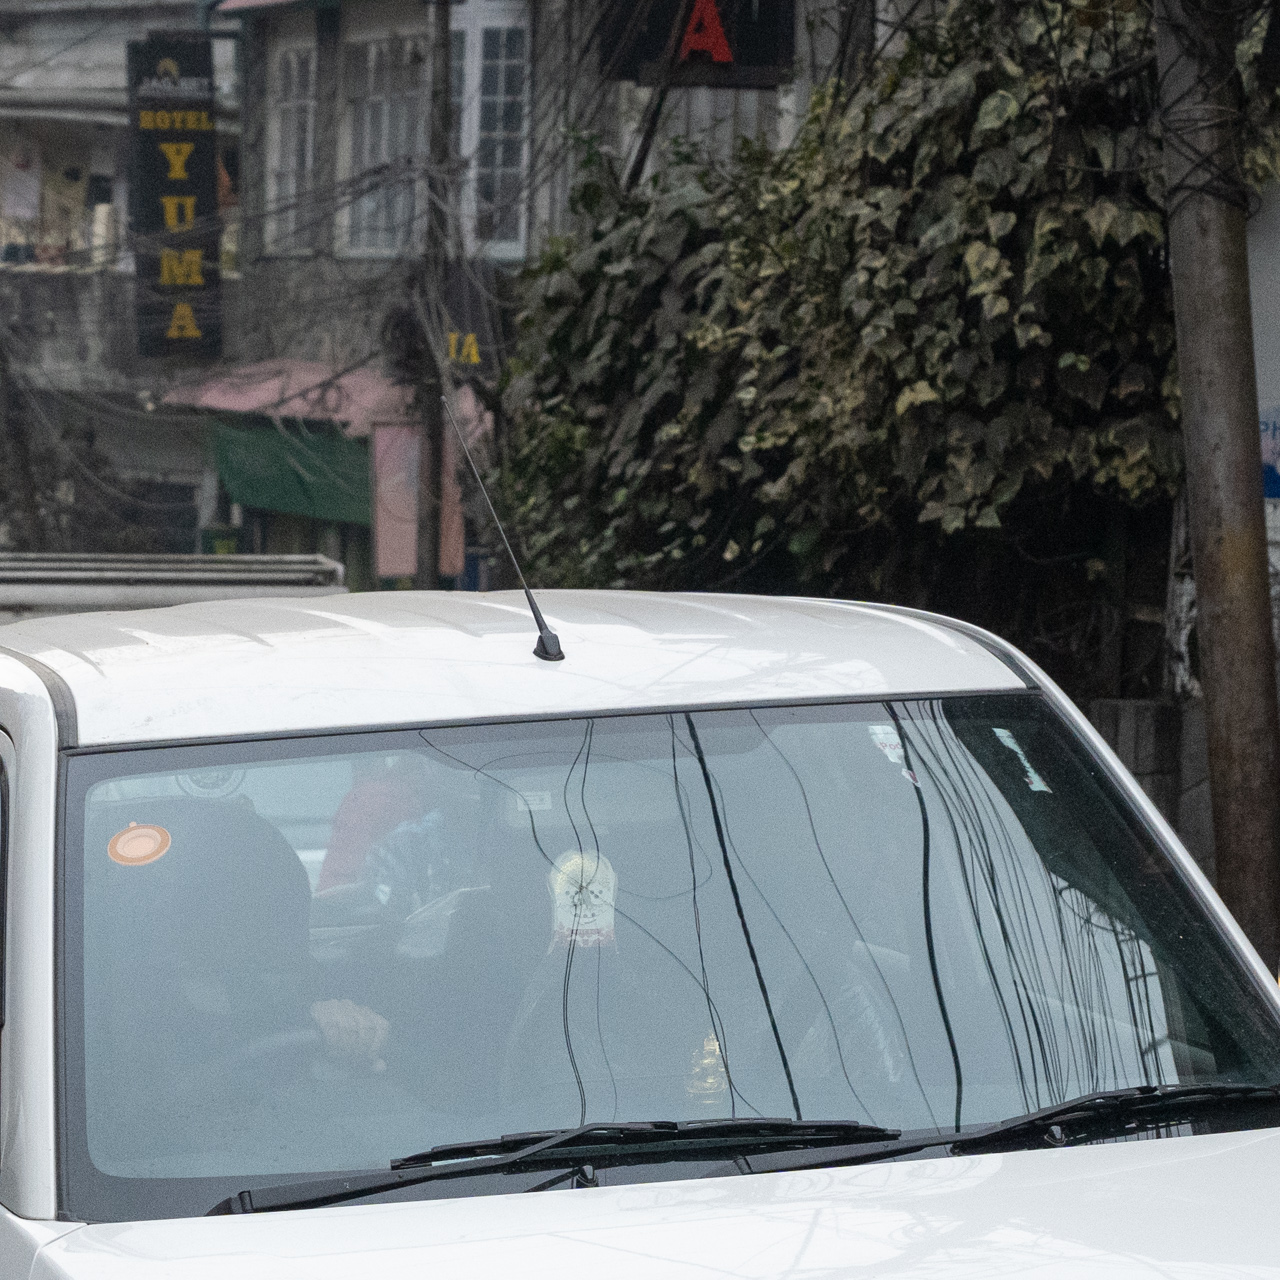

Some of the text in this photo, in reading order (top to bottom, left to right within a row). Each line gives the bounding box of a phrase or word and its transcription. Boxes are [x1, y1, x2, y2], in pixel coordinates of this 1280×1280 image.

[679, 0, 734, 62] A
[140, 110, 214, 130] HOTEL
[158, 142, 205, 339] YUMA
